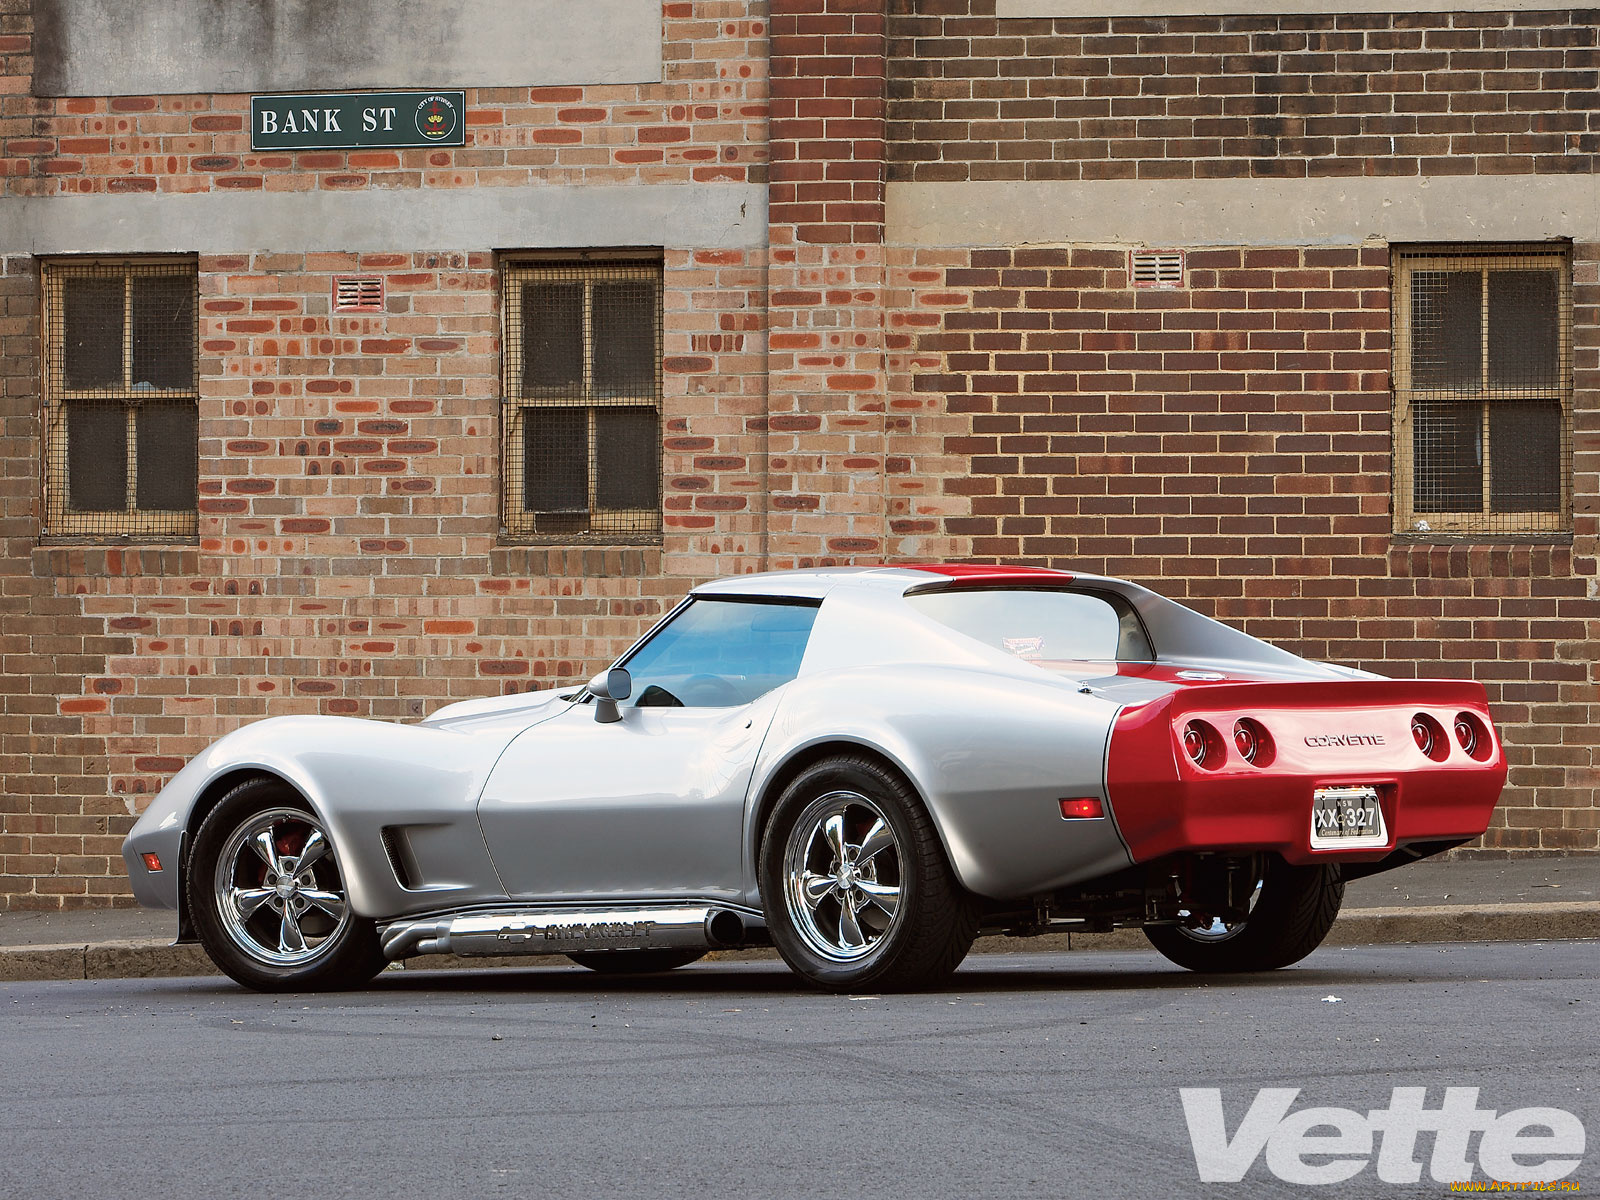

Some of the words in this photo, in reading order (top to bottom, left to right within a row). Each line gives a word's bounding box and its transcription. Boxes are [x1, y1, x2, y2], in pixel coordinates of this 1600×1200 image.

[417, 98, 428, 110] CITY
[260, 108, 342, 134] BANK
[362, 107, 396, 132] ST
[1304, 734, 1386, 748] CORVETTE
